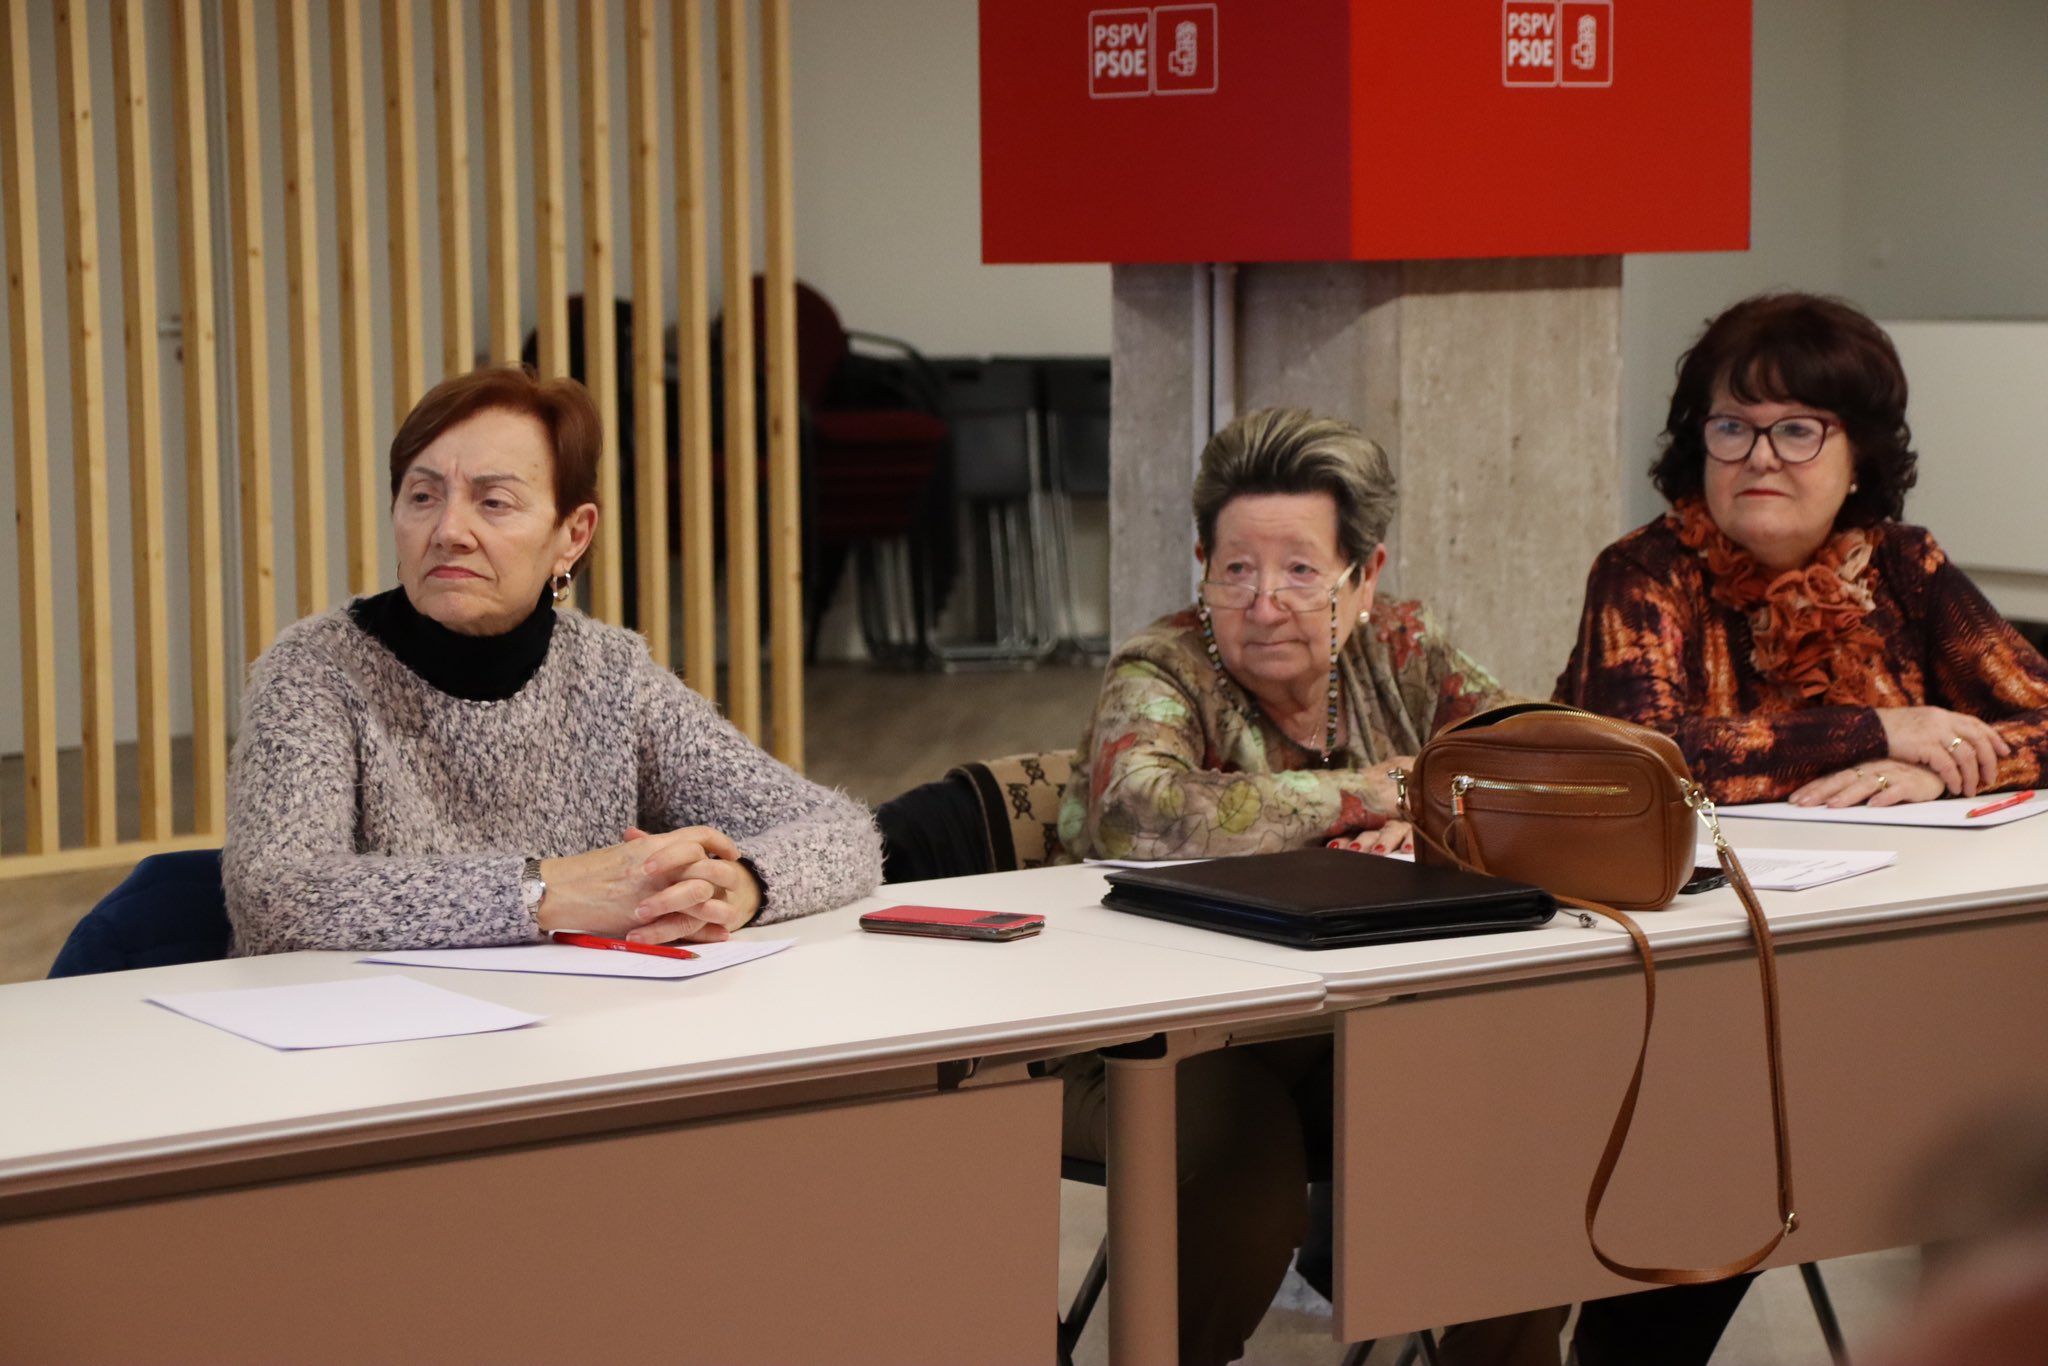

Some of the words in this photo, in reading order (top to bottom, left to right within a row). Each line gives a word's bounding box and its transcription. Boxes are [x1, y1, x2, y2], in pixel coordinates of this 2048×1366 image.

[1094, 22, 1148, 48] PSPV
[1508, 12, 1555, 36] PSPV
[1094, 49, 1147, 78] PSOE
[1508, 38, 1554, 67] PSOE
